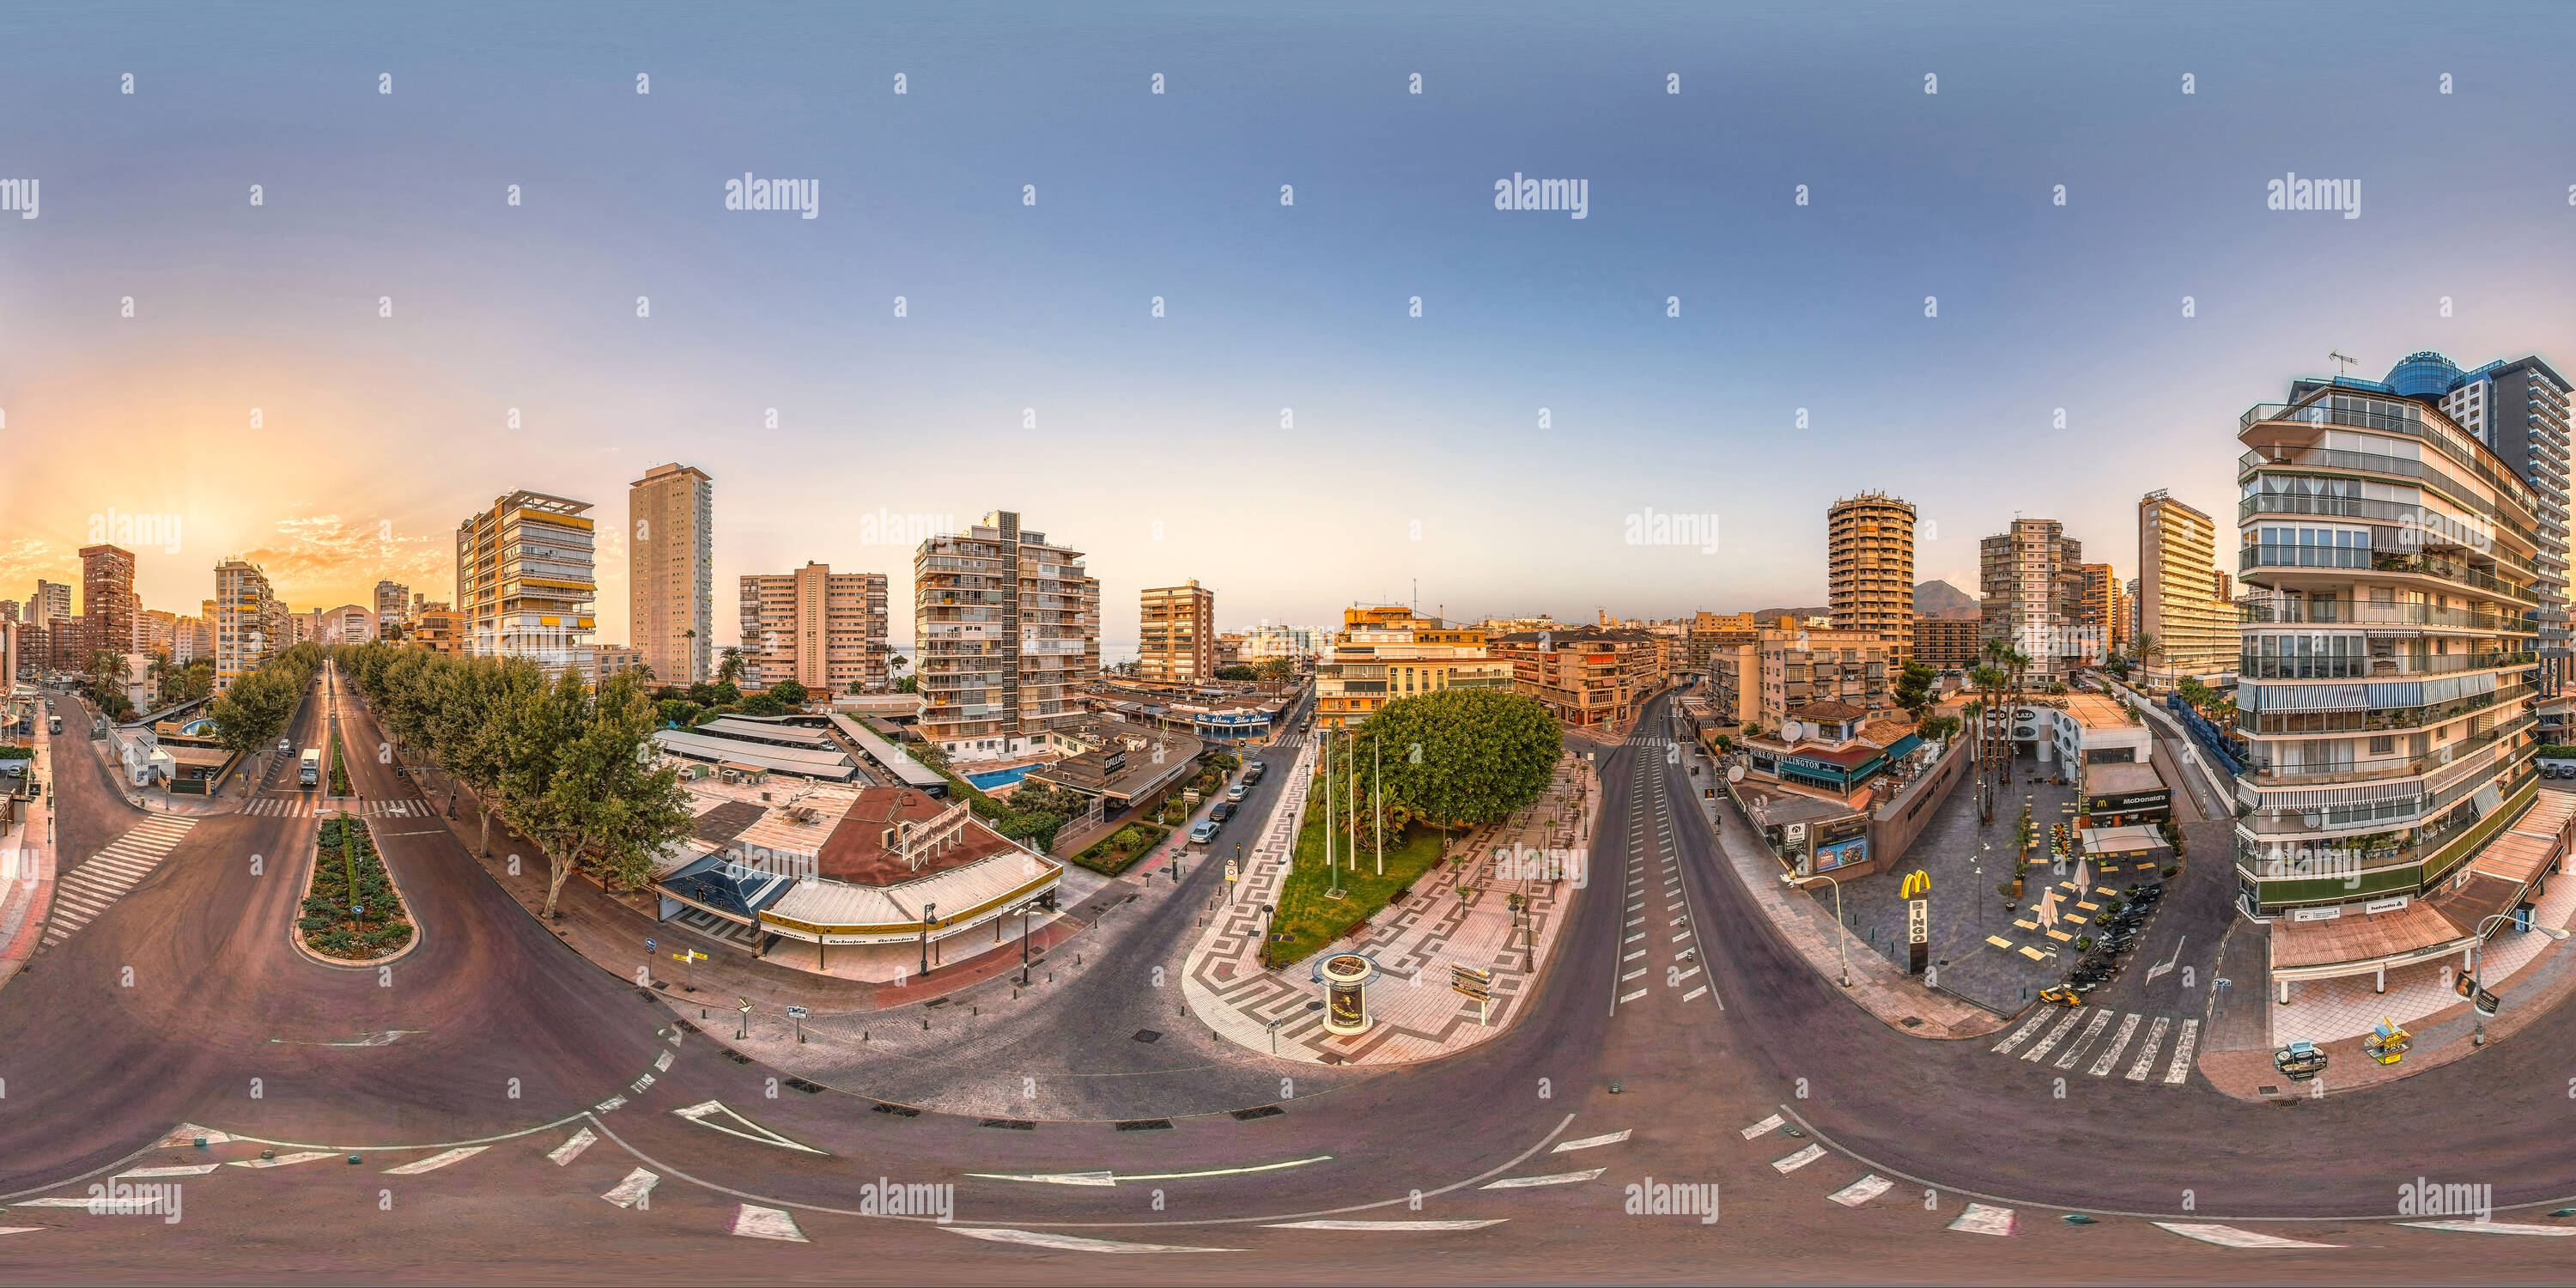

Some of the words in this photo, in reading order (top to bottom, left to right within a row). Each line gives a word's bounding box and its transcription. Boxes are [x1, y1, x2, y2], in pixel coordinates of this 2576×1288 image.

[1212, 715, 1230, 724] Shoes
[1251, 714, 1268, 723] Shoes
[1105, 752, 1126, 770] DALLAS
[1749, 749, 1766, 758] DUKE
[1767, 752, 1775, 761] OF
[1776, 755, 1820, 770] WELLINGTON
[2123, 794, 2166, 805] McDonald's
[2371, 902, 2396, 911] helvetia
[1912, 902, 1925, 943] BINGO
